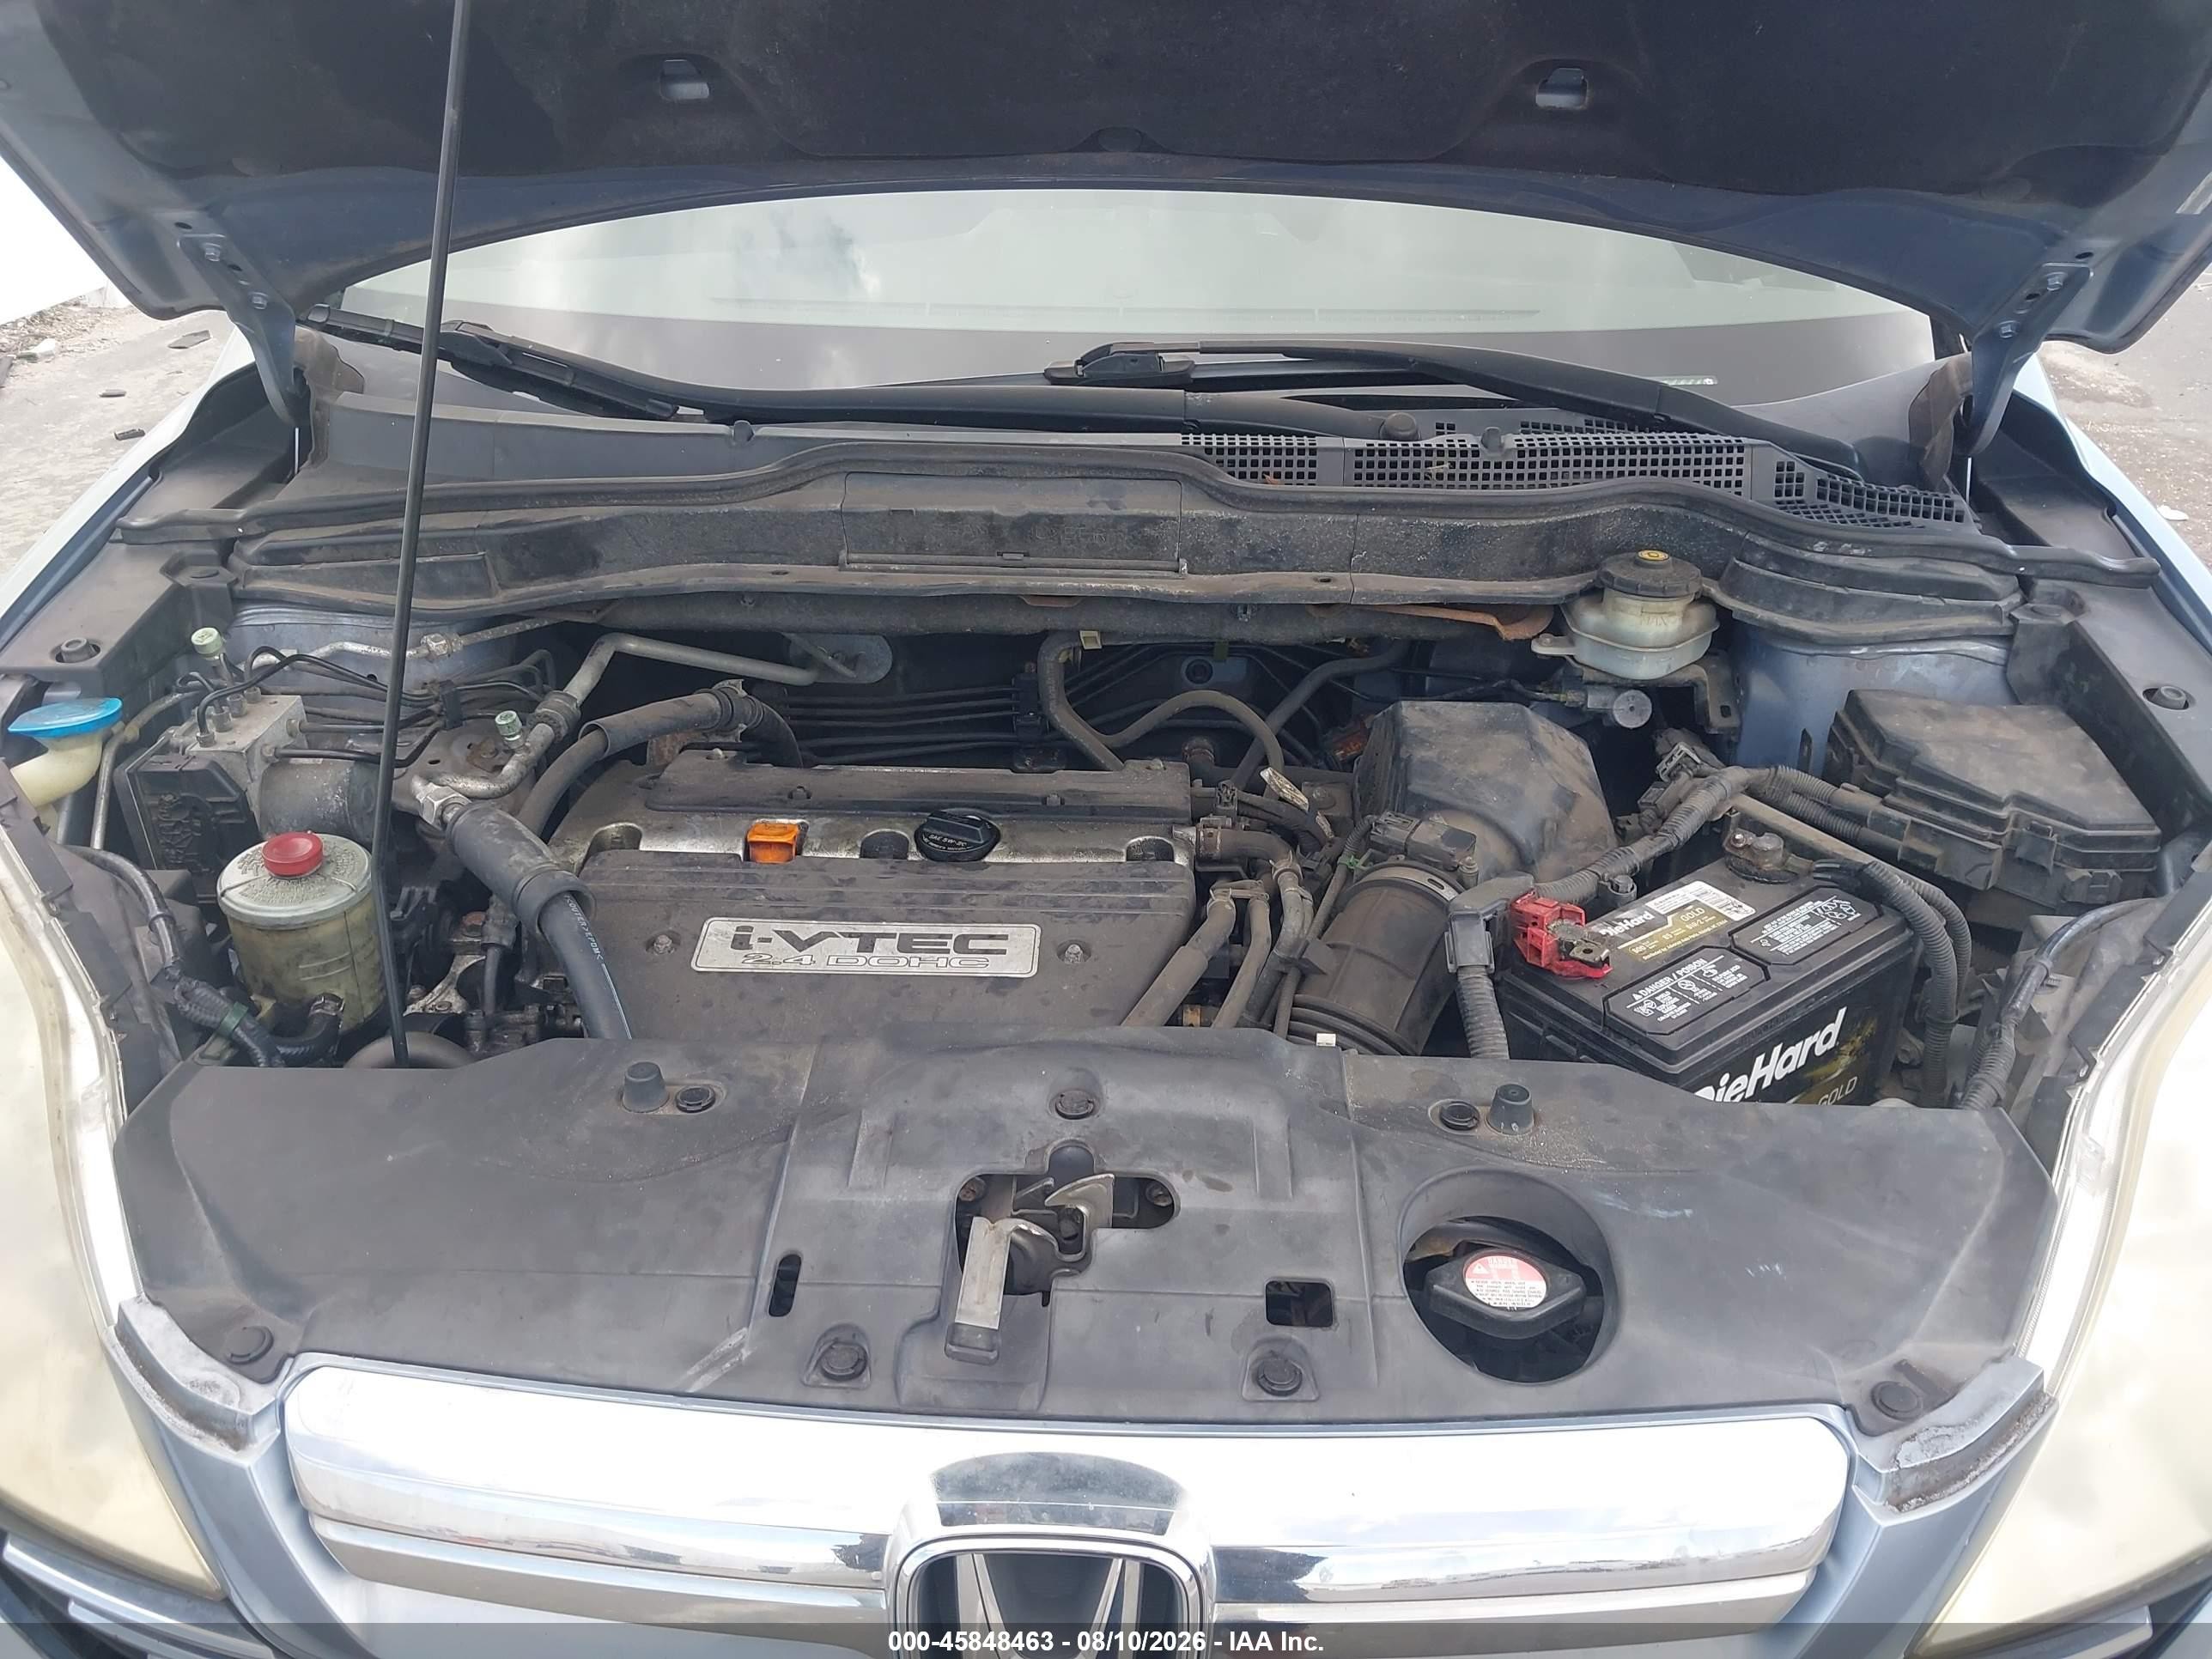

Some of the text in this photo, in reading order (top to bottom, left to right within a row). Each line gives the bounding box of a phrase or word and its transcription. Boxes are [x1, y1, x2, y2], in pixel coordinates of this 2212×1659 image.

[1680, 907, 1706, 922] GOLD
[730, 925, 1009, 956] i-VTEC
[741, 952, 990, 969] 2.4 DOHC
[1638, 974, 1674, 997] DANGER
[1676, 957, 1709, 977] POISON
[1818, 1076, 1857, 1106] GOLD
